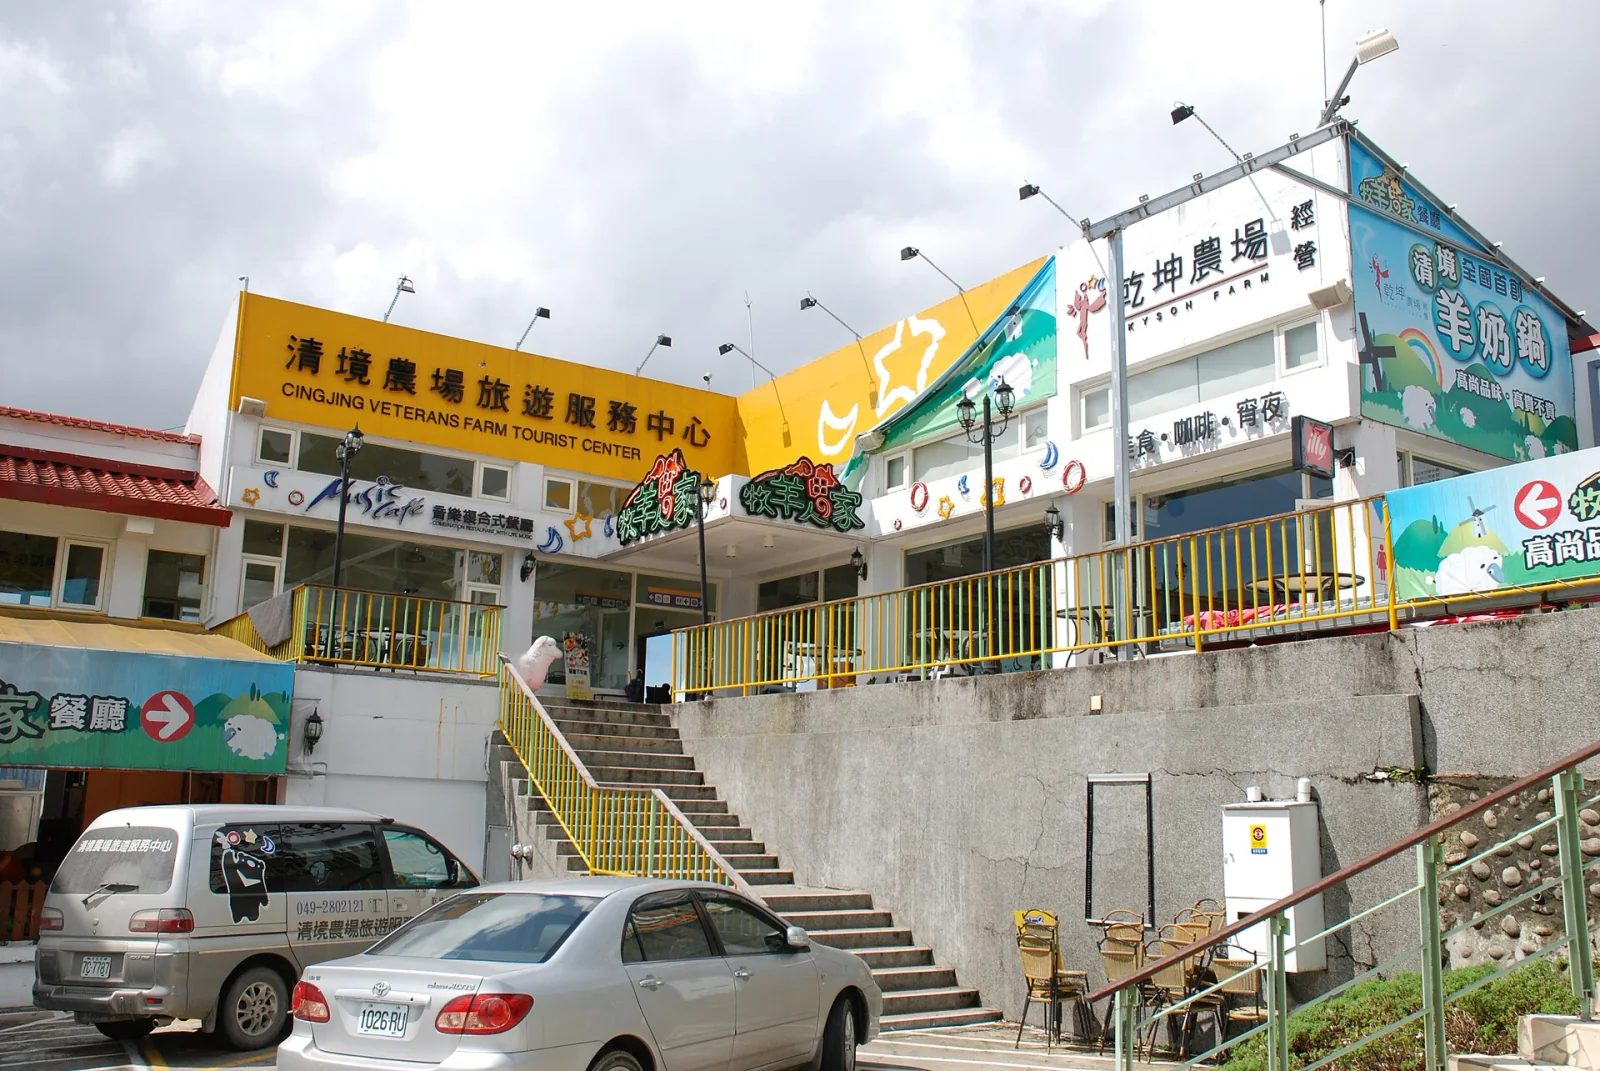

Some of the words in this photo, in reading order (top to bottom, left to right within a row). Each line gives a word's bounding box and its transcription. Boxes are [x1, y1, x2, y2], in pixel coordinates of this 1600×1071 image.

[1291, 199, 1317, 273] 經營
[1123, 217, 1269, 310] 乾坤農場
[1412, 244, 1458, 289] 清境
[1461, 257, 1524, 303] 全國首創
[1127, 300, 1194, 333] KYSON
[1213, 271, 1270, 301] FARM
[1434, 288, 1547, 370] 羊奶鍋
[286, 334, 711, 448] 清境農場旅遊服務中心
[282, 383, 365, 411] CINGJING
[369, 399, 460, 428] VETERANS
[463, 417, 508, 437] FARM
[512, 426, 578, 449] TOURIST
[582, 439, 642, 461] CENTER
[1306, 431, 1327, 461] illy
[50, 694, 127, 733] 餐廳
[296, 900, 365, 915] 049-2802121
[297, 915, 414, 941] 清境農場旅遊服
